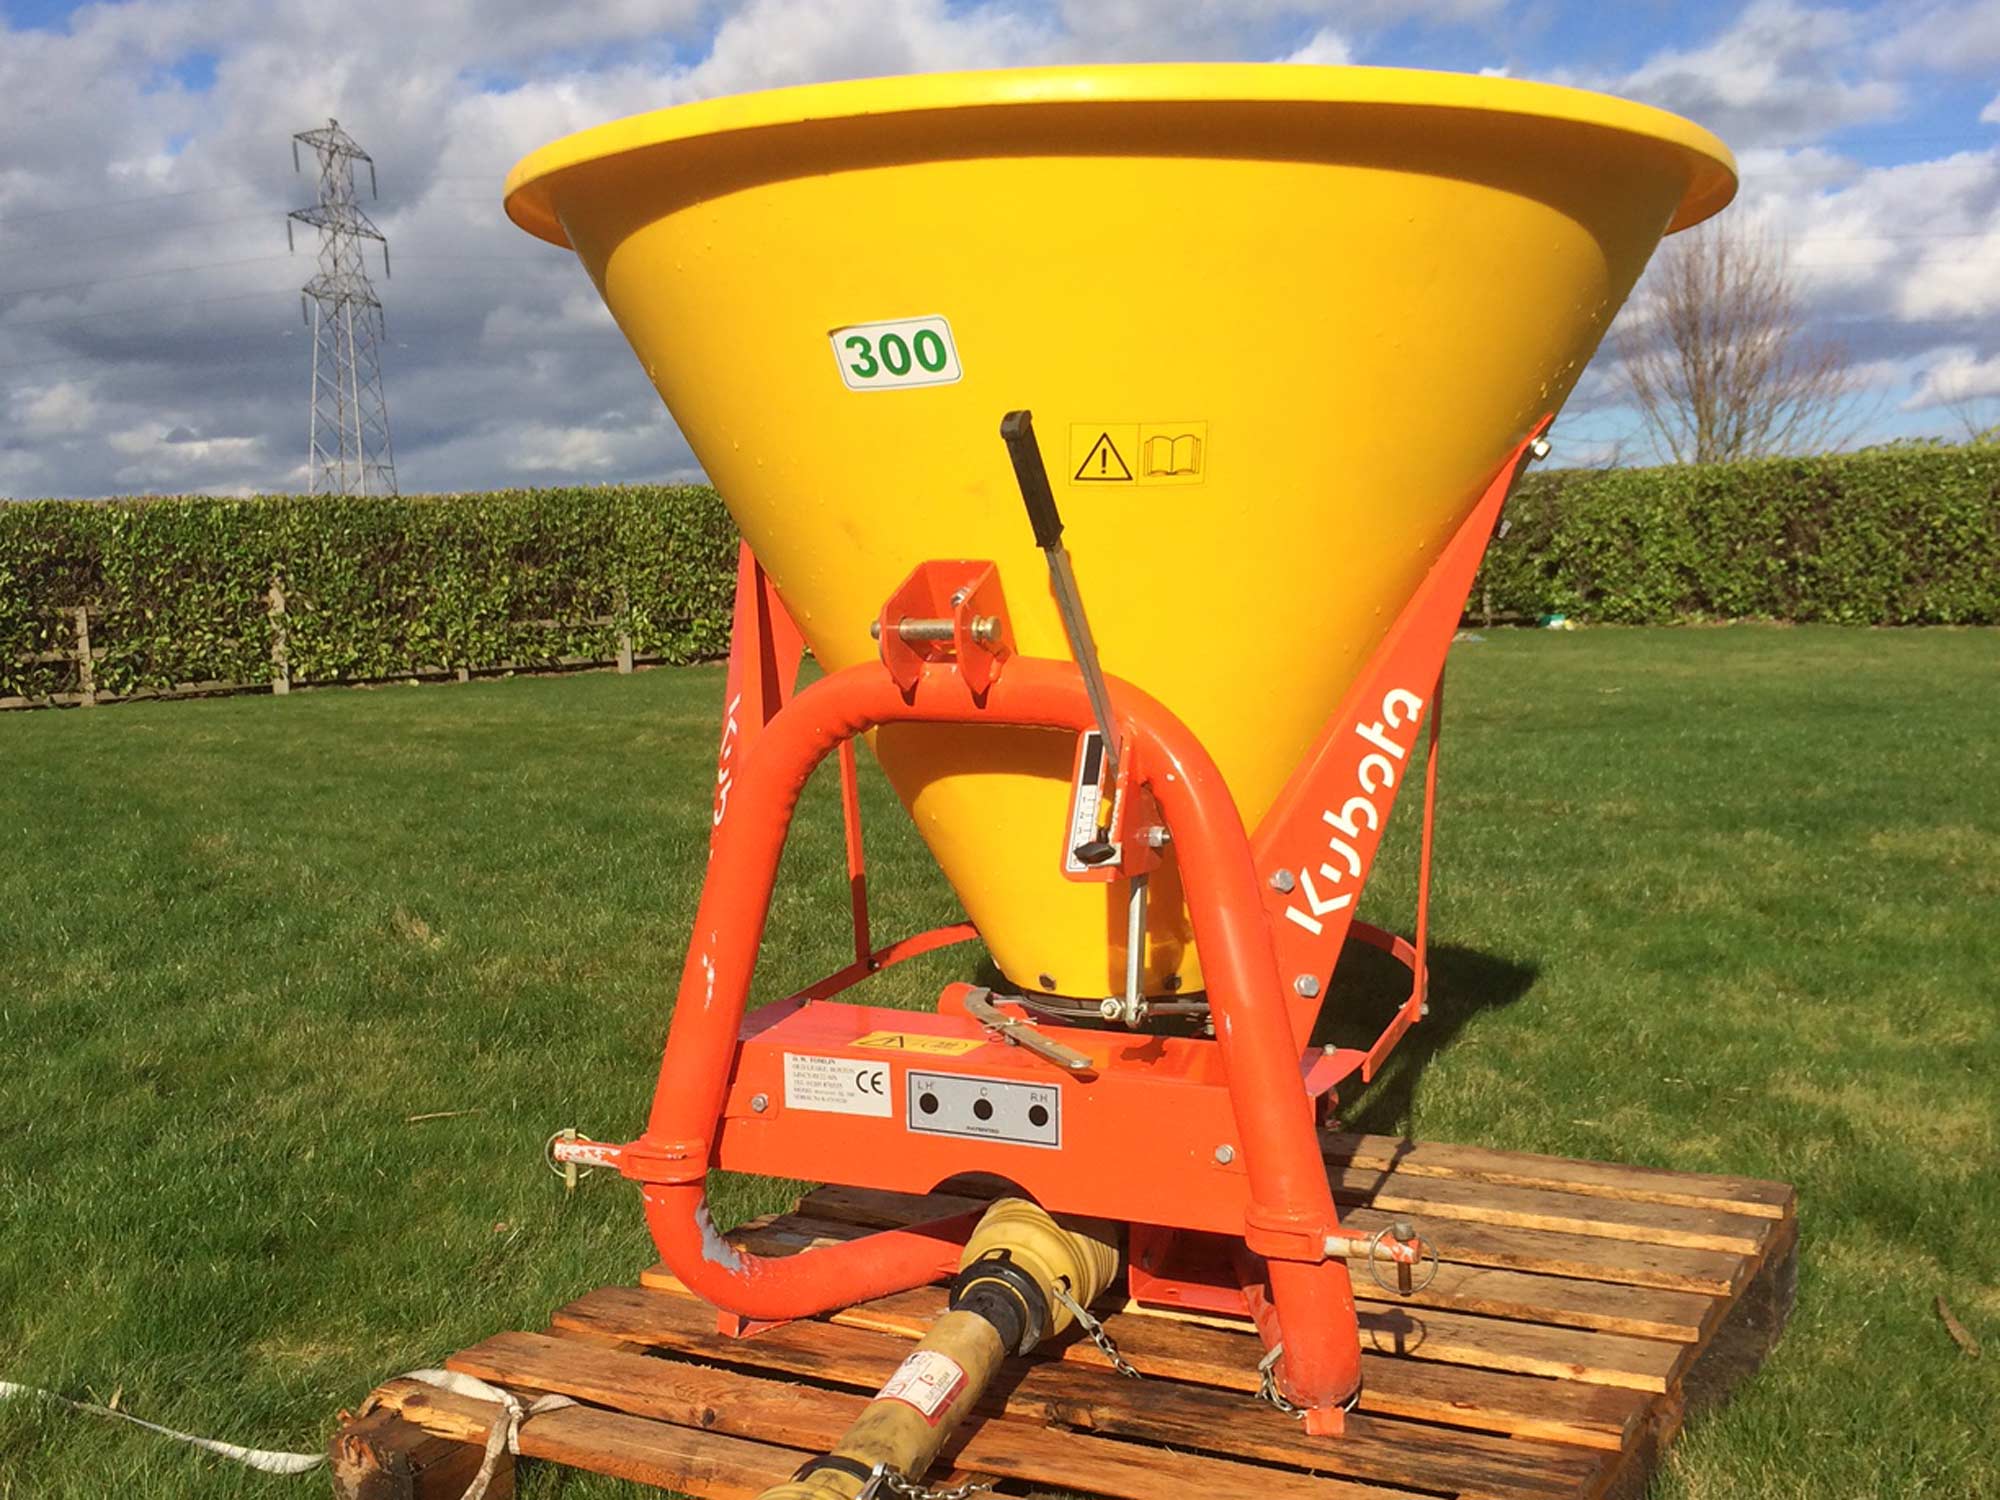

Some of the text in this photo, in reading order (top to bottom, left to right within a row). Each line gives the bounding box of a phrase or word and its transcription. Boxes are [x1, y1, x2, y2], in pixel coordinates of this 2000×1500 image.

[845, 329, 947, 378] 300
[1285, 688, 1423, 935] Kubota
[856, 1070, 884, 1095] CE
[980, 1087, 988, 1097] C
